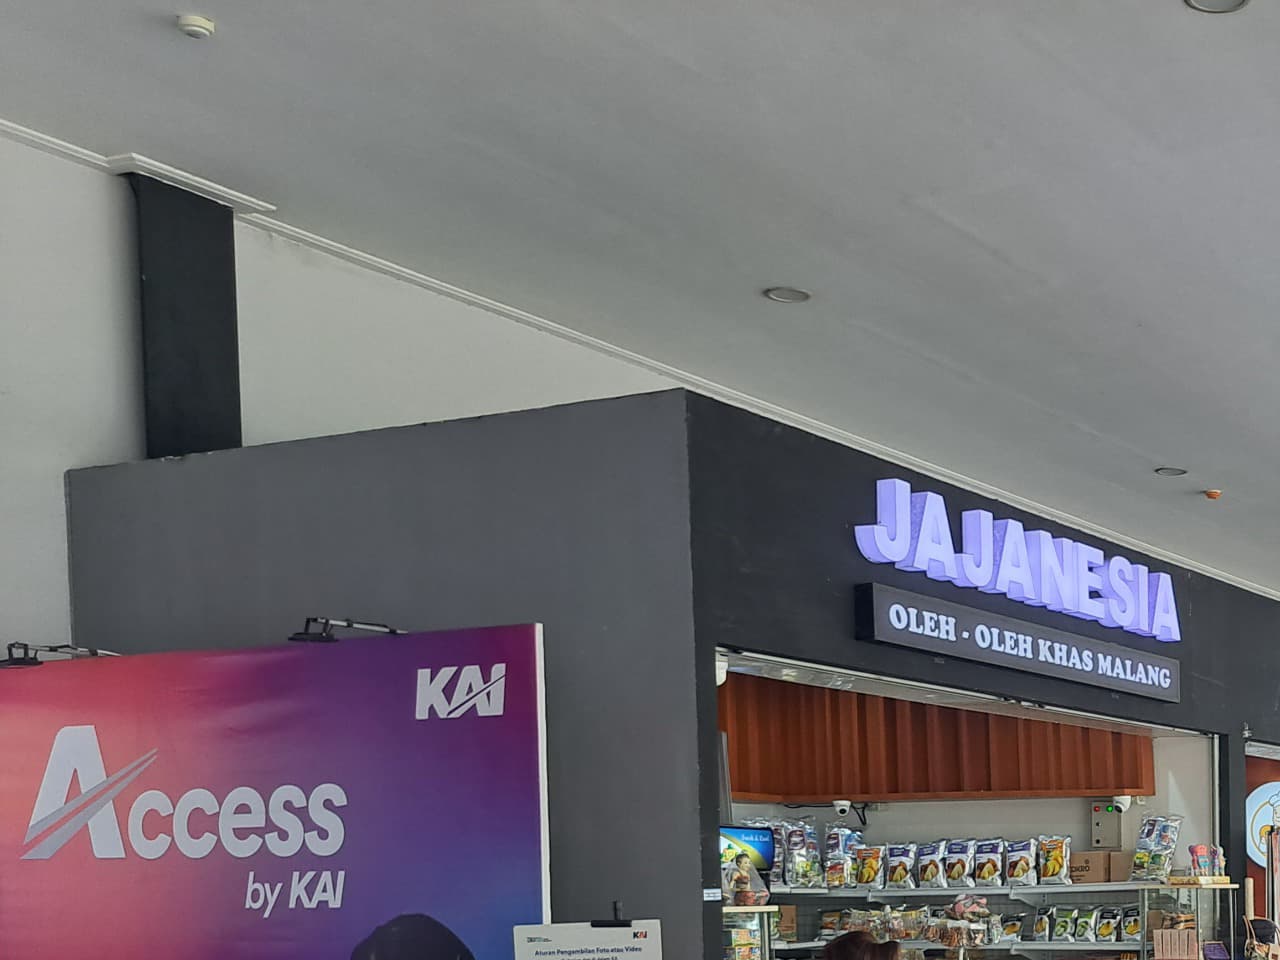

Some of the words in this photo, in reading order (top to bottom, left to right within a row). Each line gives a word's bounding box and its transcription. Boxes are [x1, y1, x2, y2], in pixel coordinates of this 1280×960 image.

[854, 478, 1182, 643] JAJANESIA
[889, 604, 957, 642] OLEH
[975, 624, 1033, 659] OLEH
[1038, 640, 1094, 672] KHAS
[1097, 653, 1172, 689] MALANG
[415, 663, 507, 720] KAI
[20, 725, 348, 860] Access
[245, 872, 281, 918] by
[288, 870, 346, 909] KAI
[624, 945, 642, 953] Video
[632, 931, 648, 940] KAI
